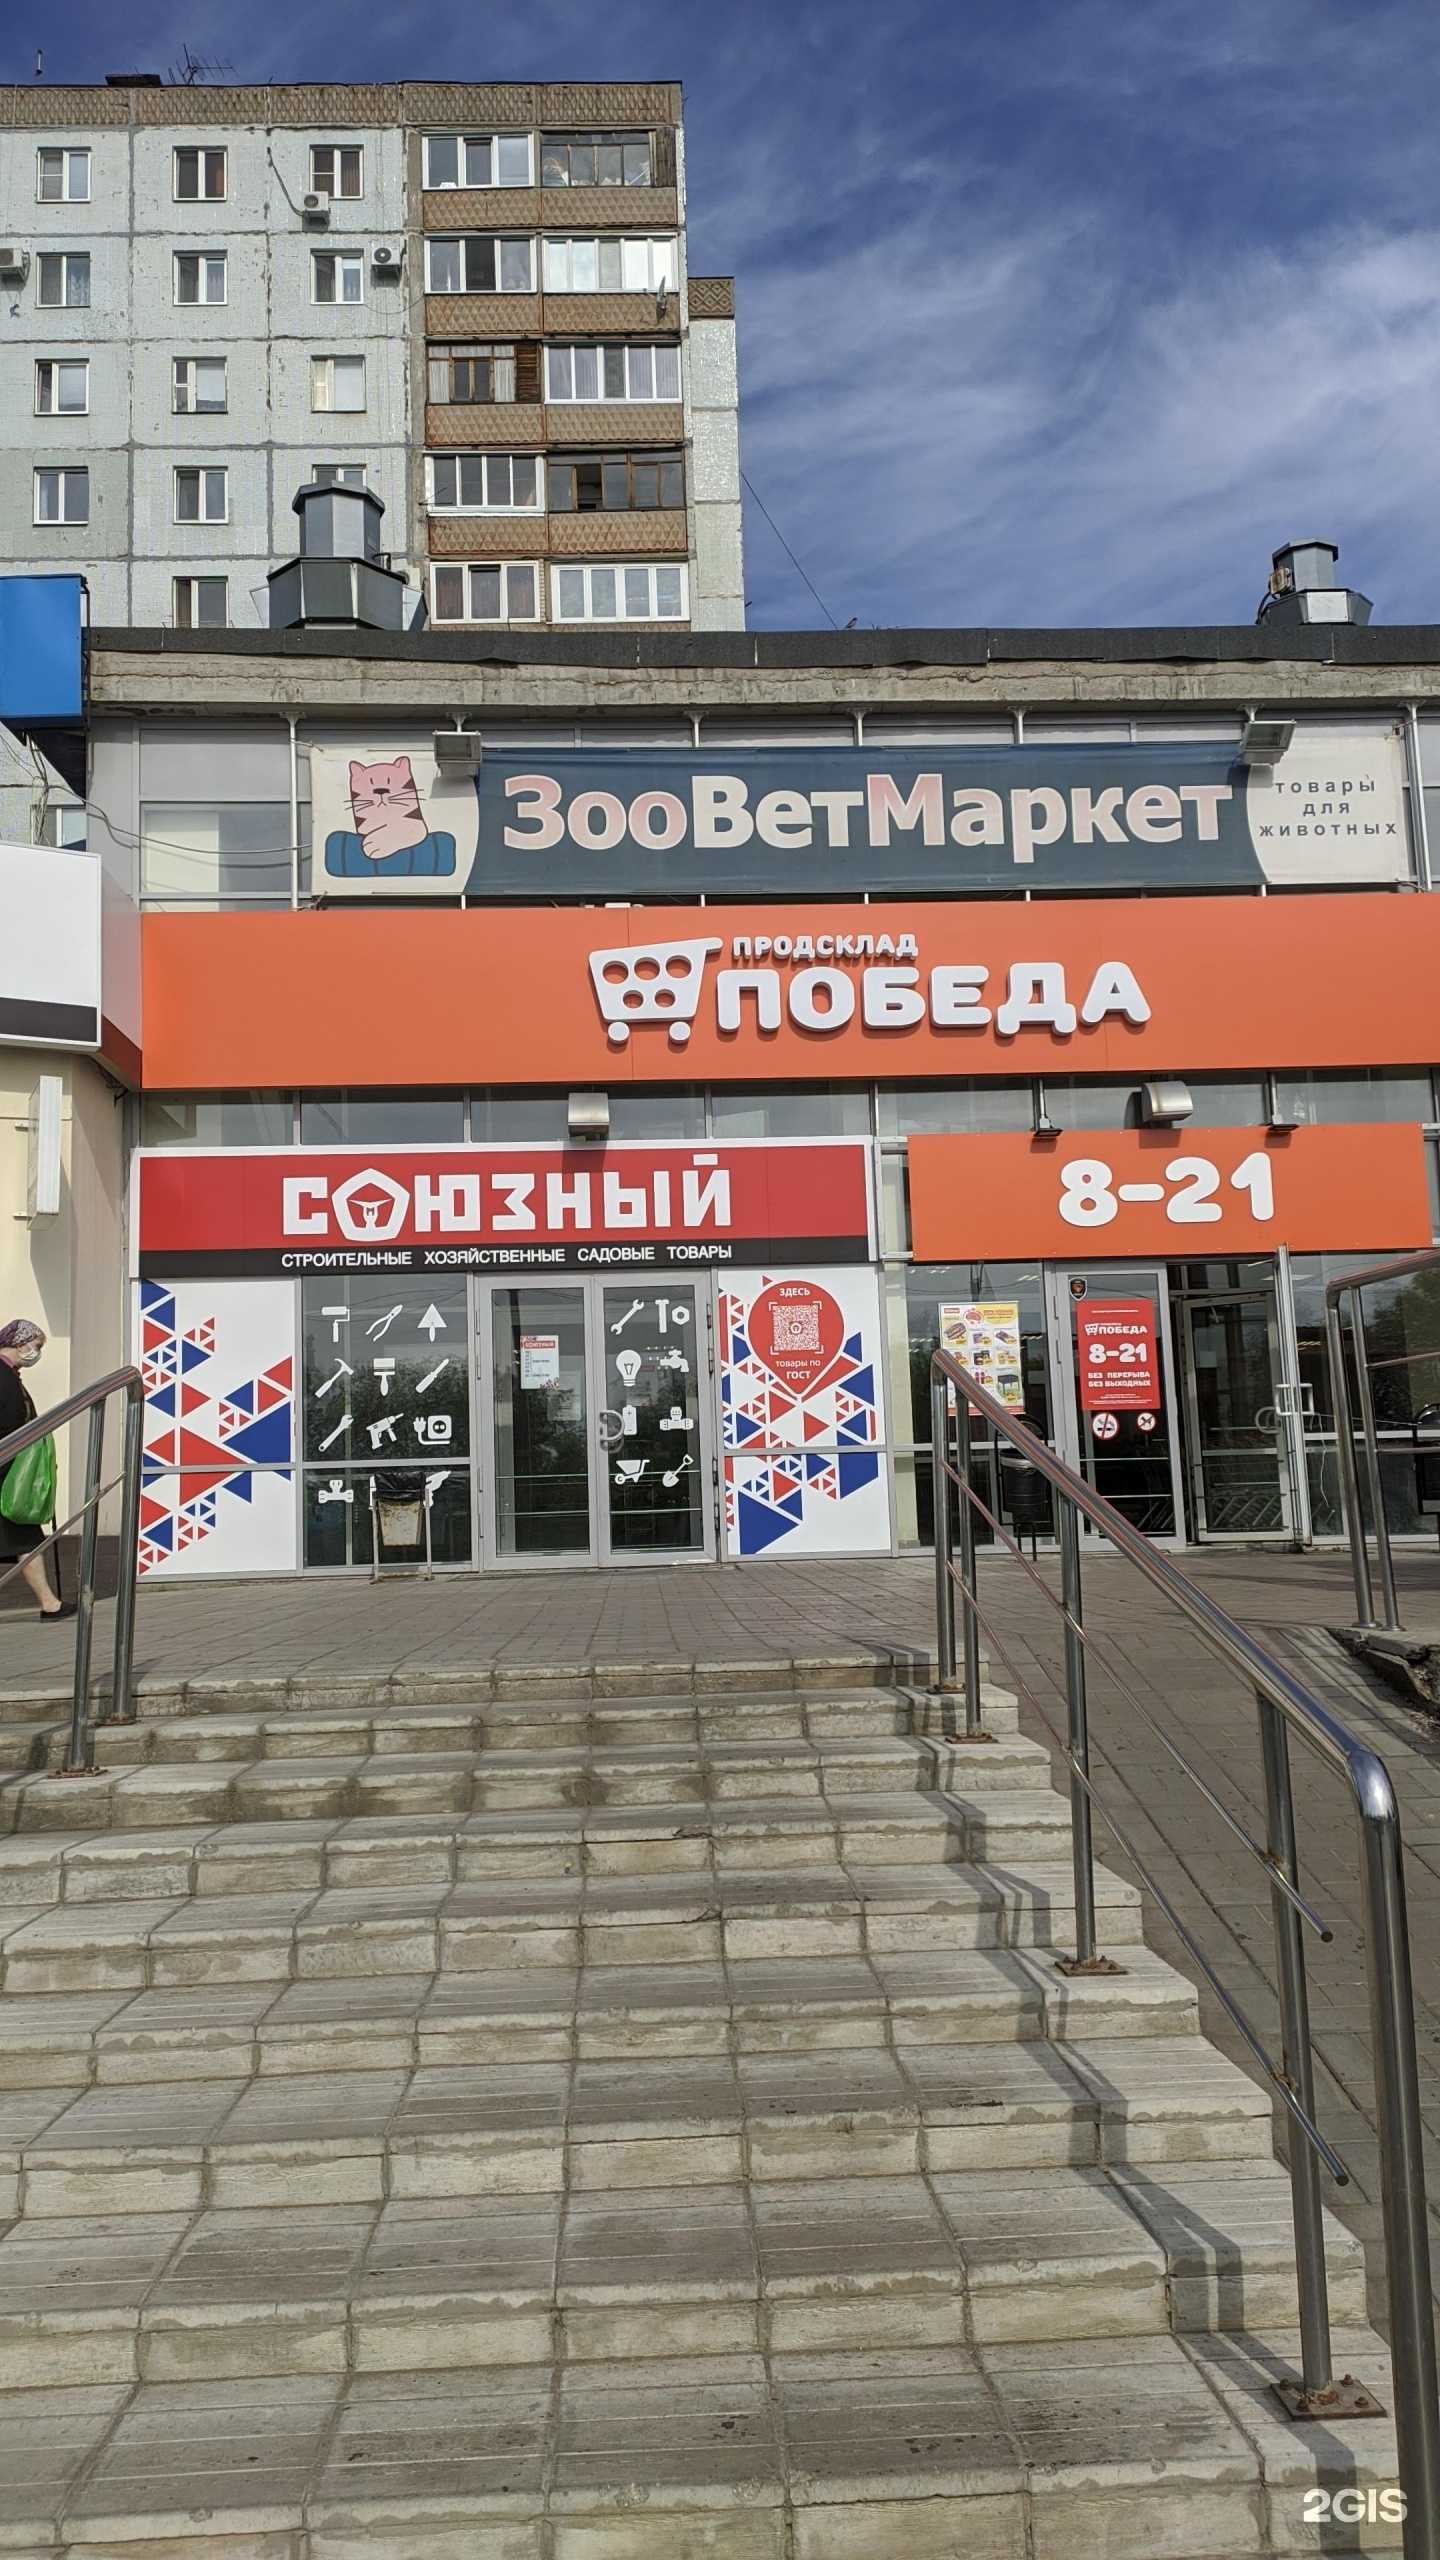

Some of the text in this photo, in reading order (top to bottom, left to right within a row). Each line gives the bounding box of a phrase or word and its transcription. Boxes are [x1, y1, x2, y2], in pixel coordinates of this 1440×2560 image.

[1275, 780, 1375, 796] товары
[1303, 802, 1350, 817] для
[503, 773, 1233, 863] ЗооВетМаркет
[1259, 823, 1397, 837] животных
[733, 934, 919, 960] ПРОДСКЛАД
[716, 961, 1152, 1037] ПОБЕДА
[282, 1153, 732, 1242] СОЮЗНЫЙ
[281, 1245, 733, 1268] СТРОИТЕЛЬНЫЕ ХОЗЯЙСТВЕННЫЕ САДОВЫЕ ТОВАРЫ
[779, 1287, 811, 1297] ЗДЕСЬ
[1098, 1325, 1148, 1335] ПОБЕДА
[786, 1370, 811, 1380] ГОСТ
